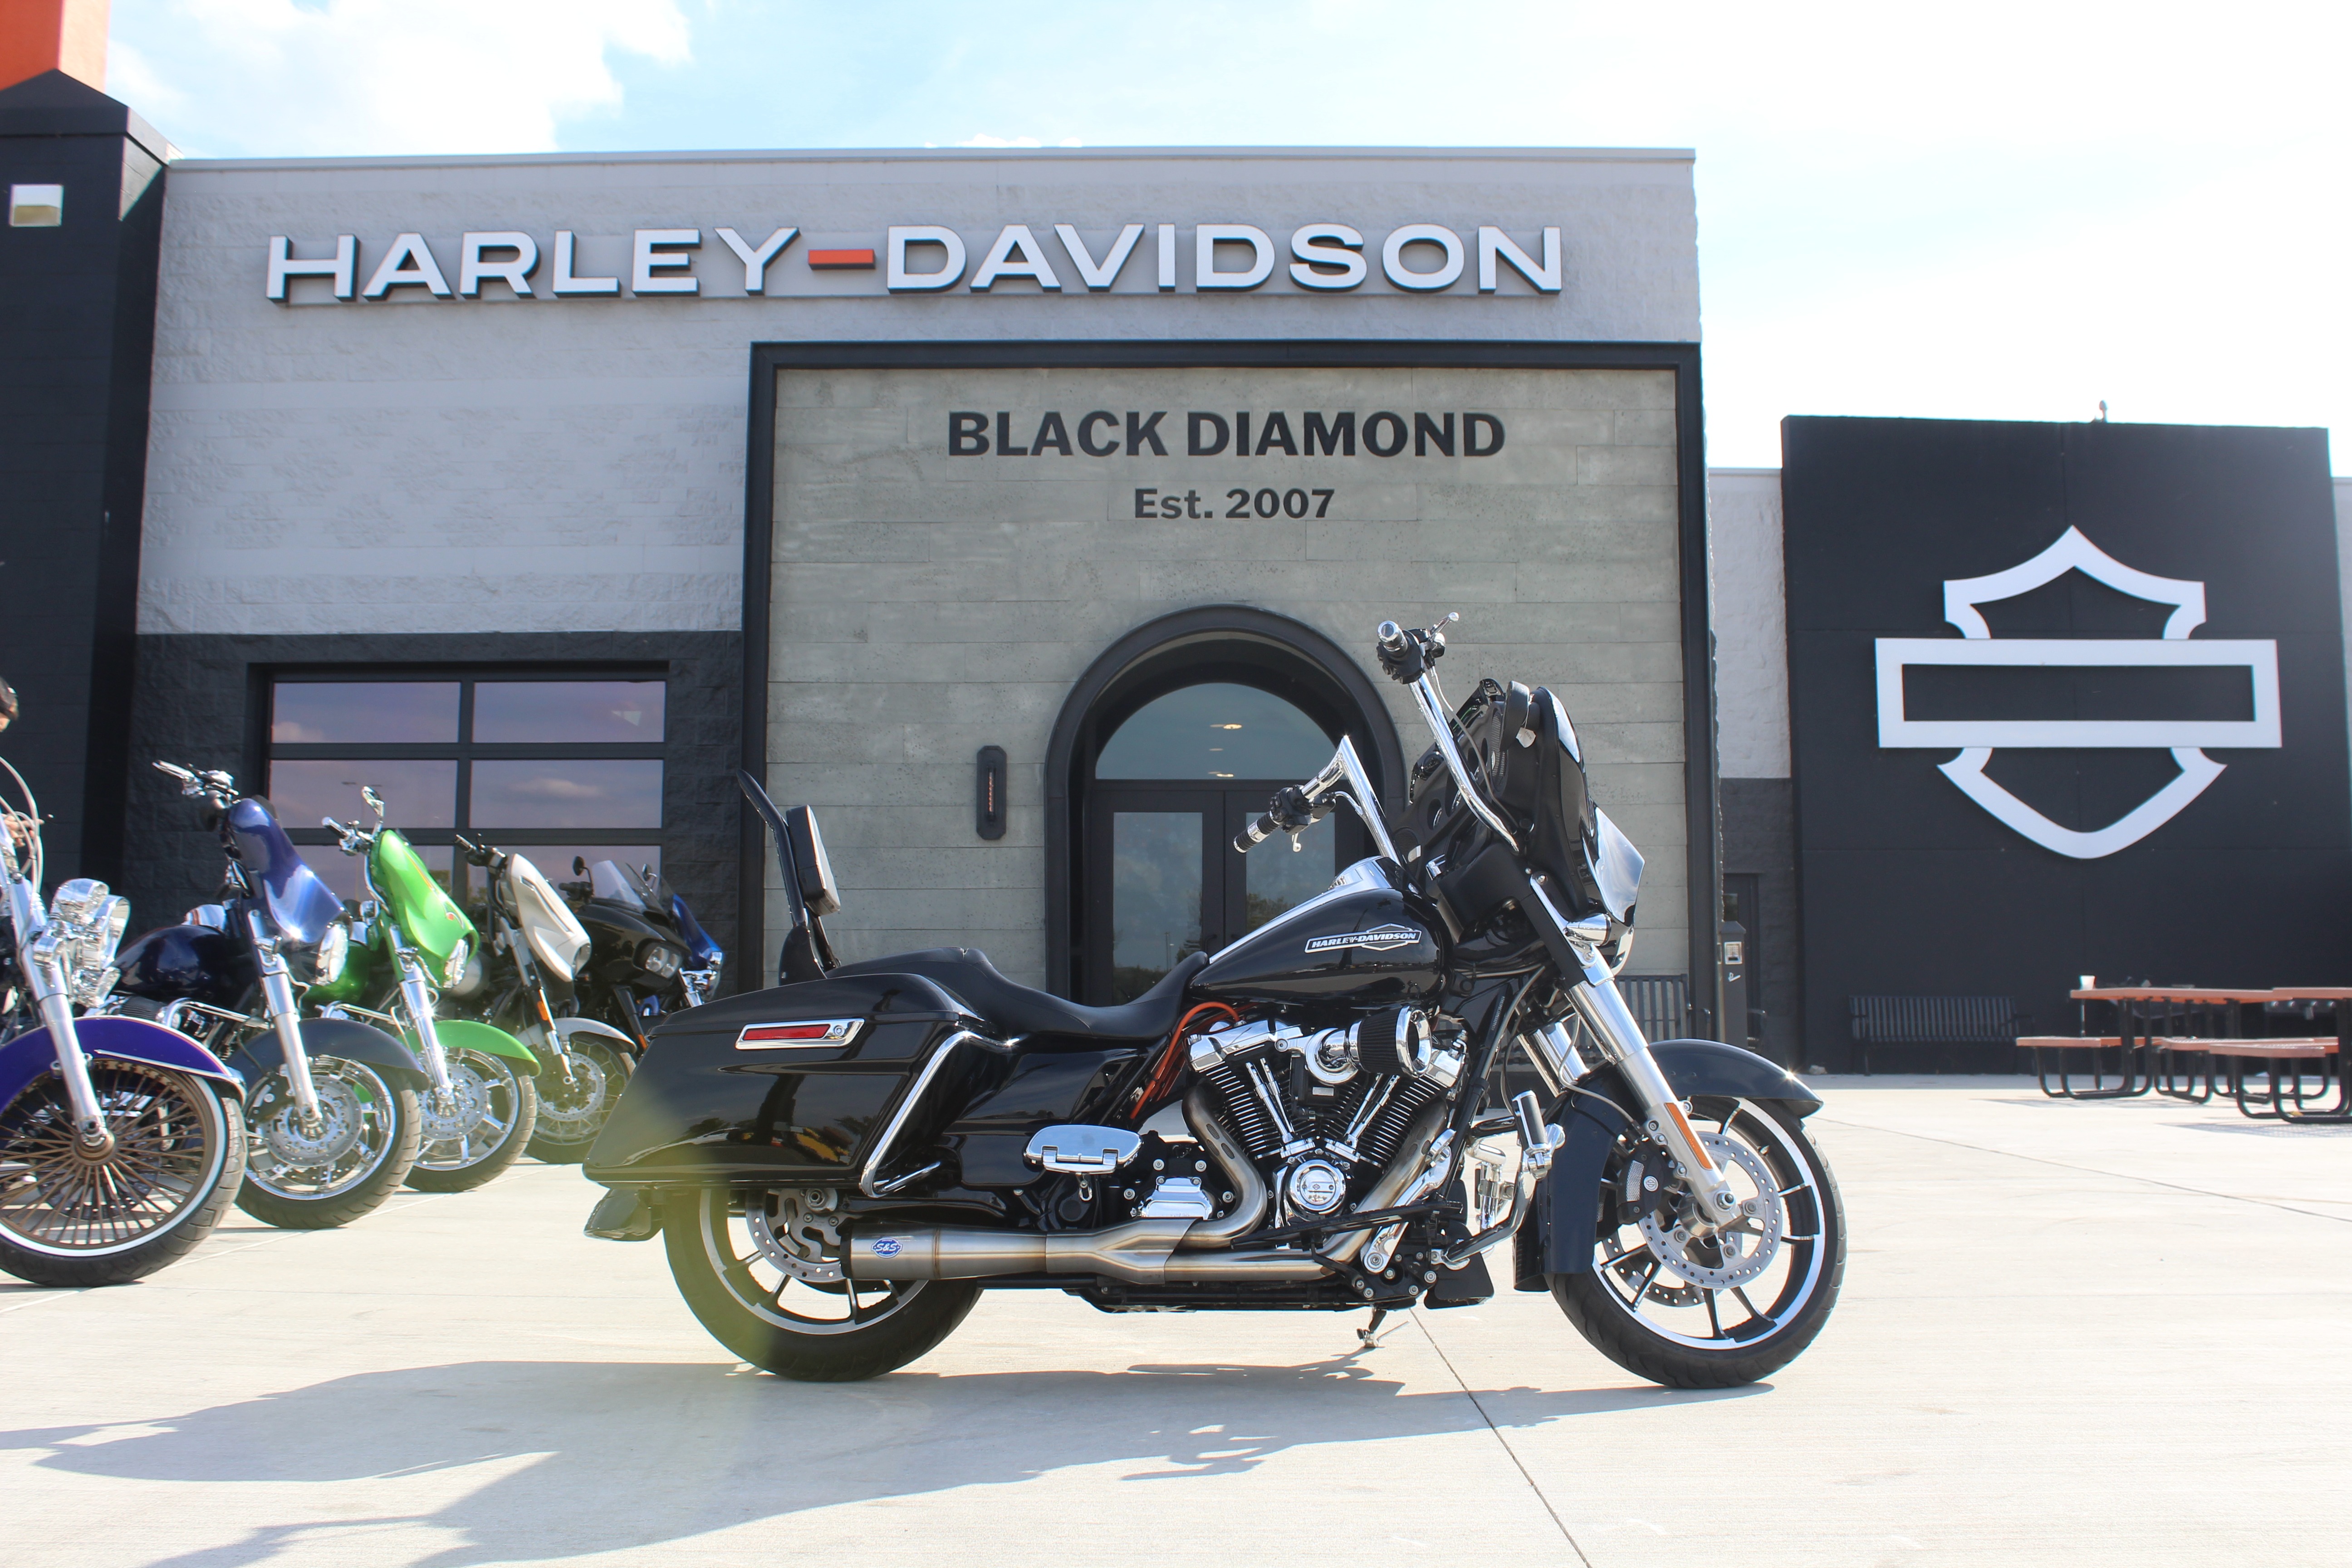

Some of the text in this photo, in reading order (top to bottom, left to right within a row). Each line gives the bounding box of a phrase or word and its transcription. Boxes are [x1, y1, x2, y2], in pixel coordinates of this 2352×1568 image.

[948, 411, 1506, 457] BLACK DIAMOND
[1134, 488, 1335, 519] Est. 2007
[1312, 933, 1416, 948] HARLEY-DAVIDSON
[876, 1243, 897, 1251] S&S
